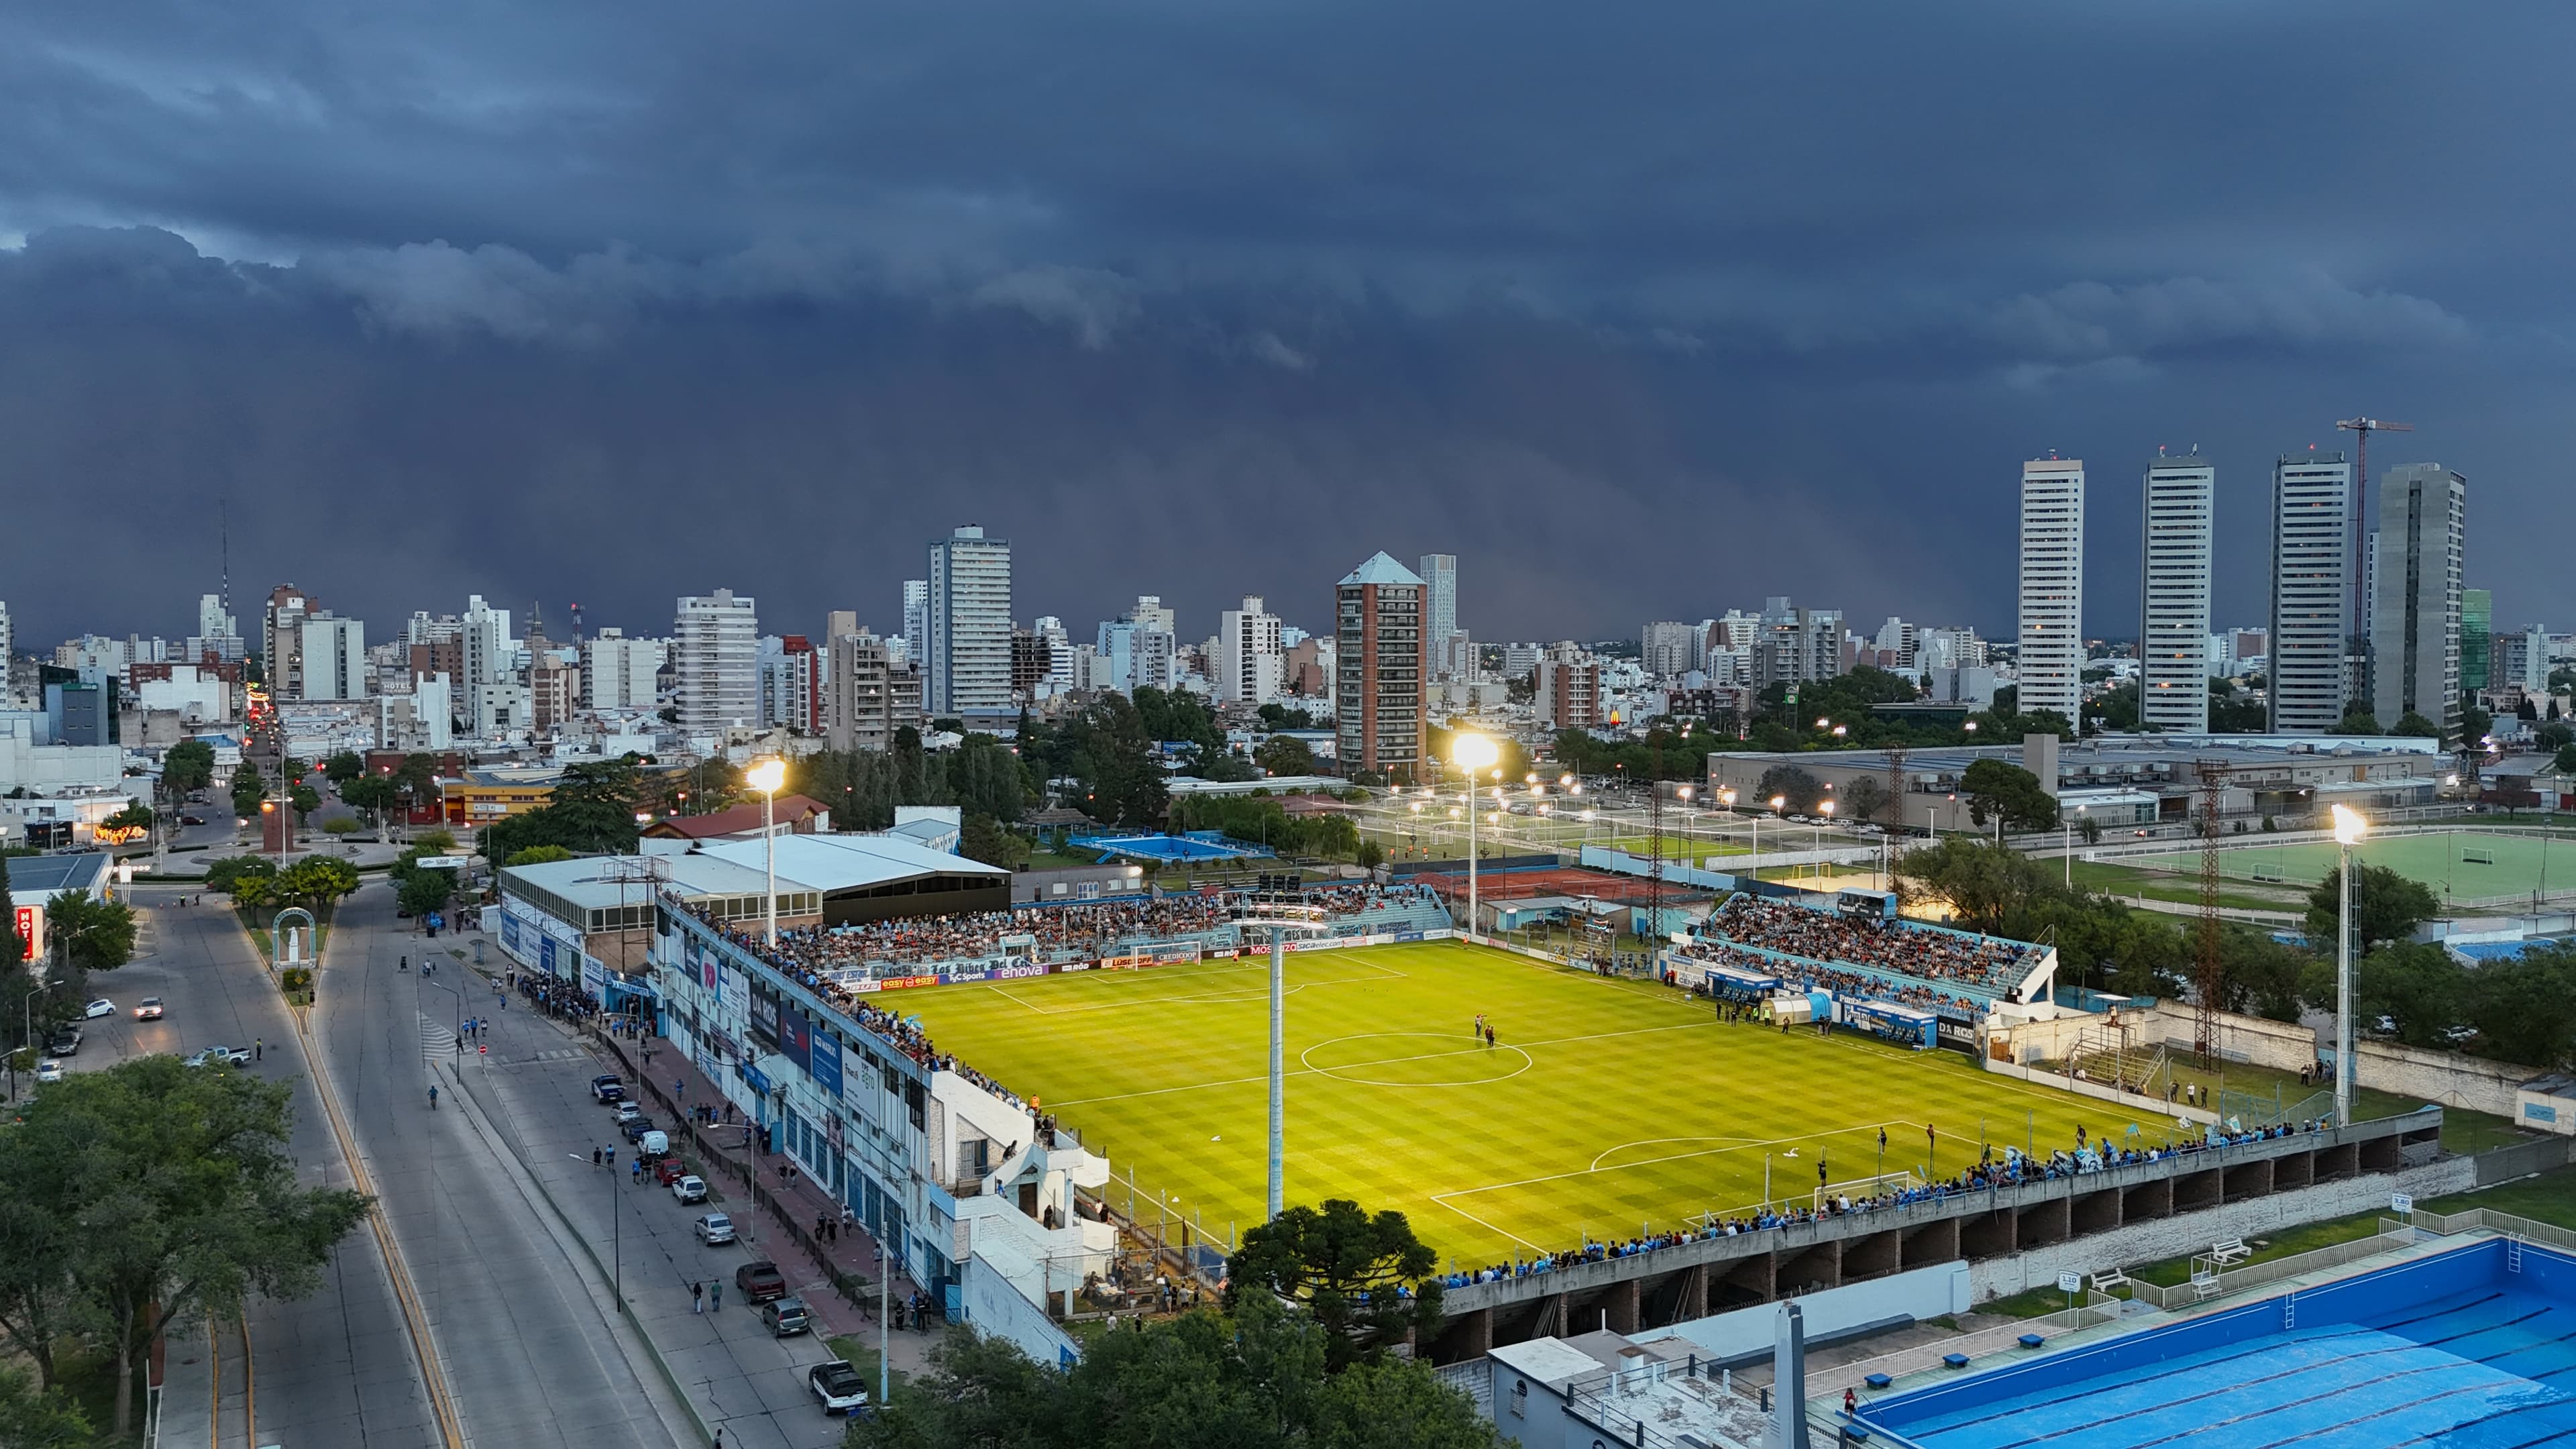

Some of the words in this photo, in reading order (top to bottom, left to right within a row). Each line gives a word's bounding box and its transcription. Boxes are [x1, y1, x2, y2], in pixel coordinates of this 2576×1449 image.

[1250, 943, 1297, 955] MOSZA
[1159, 951, 1197, 961] CREDICOOP
[948, 973, 961, 983] TyC
[962, 972, 985, 982] Sports
[1002, 966, 1043, 979] enova
[883, 980, 904, 988] easy
[915, 976, 936, 985] easy
[1783, 981, 1805, 992] Puntal
[1839, 994, 1862, 1005] Puntal
[752, 993, 762, 1015] DA
[763, 1000, 777, 1027] ROS
[1939, 1022, 1952, 1033] DA
[1953, 1025, 1974, 1039] ROS
[2062, 1275, 2077, 1283] 1.10
